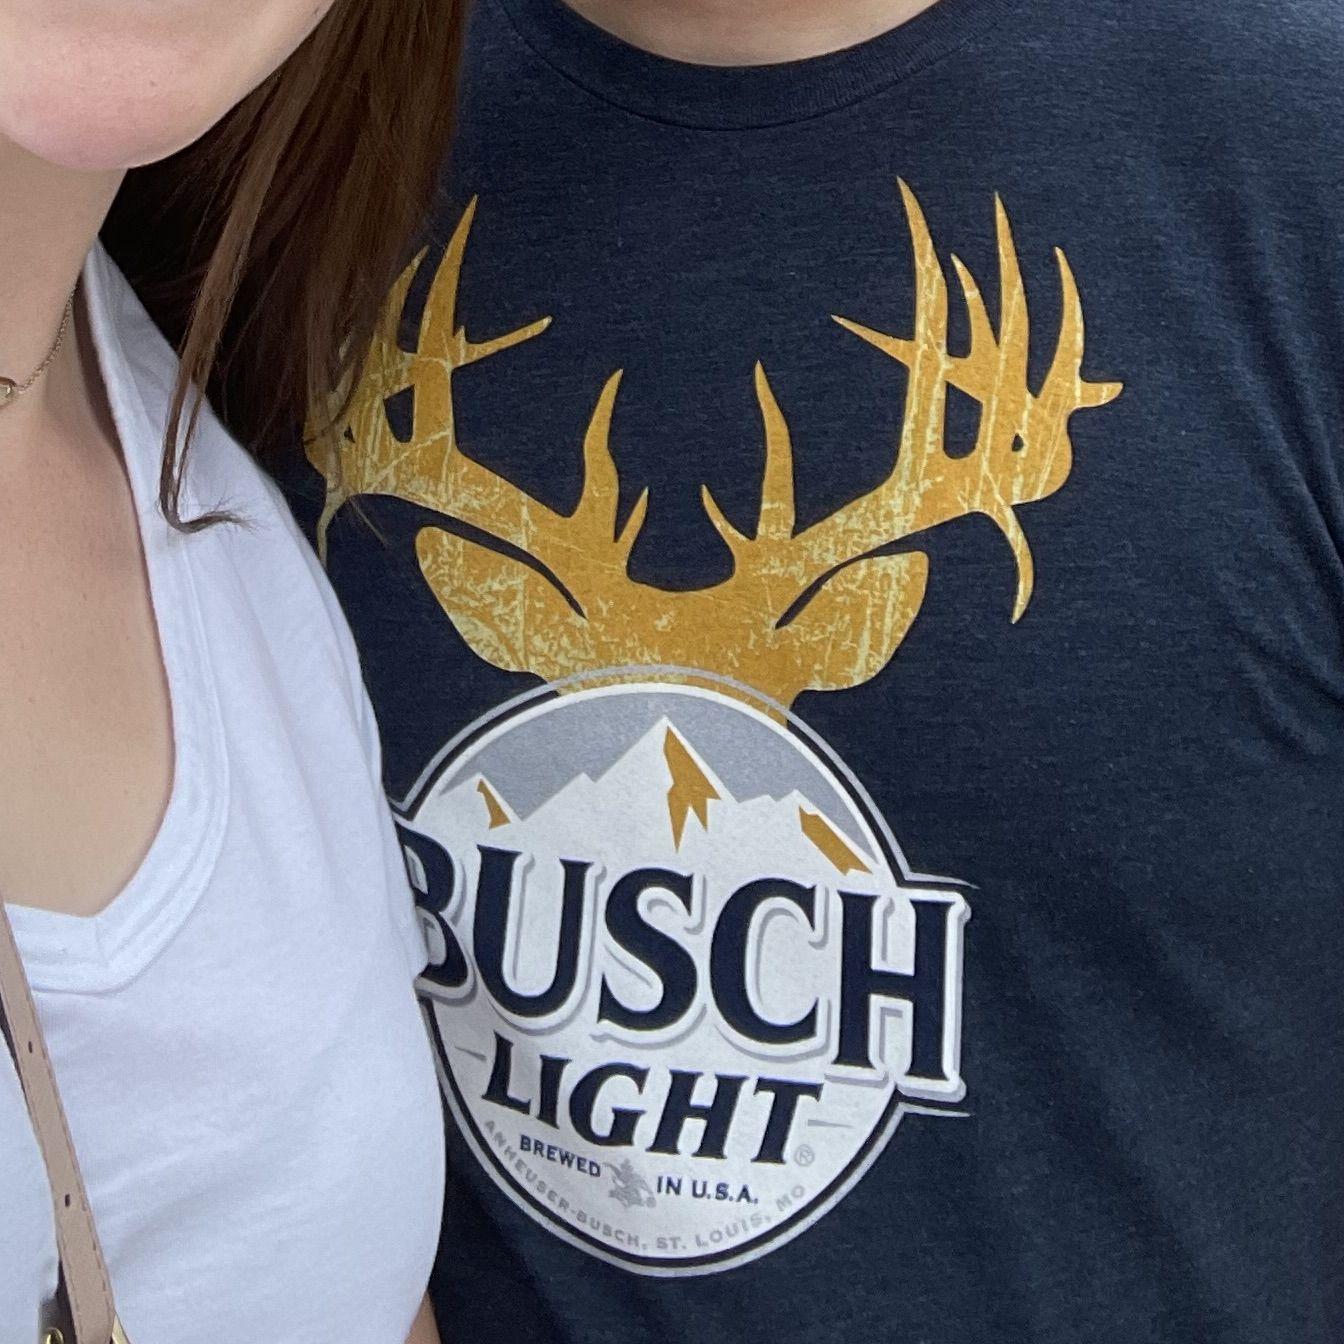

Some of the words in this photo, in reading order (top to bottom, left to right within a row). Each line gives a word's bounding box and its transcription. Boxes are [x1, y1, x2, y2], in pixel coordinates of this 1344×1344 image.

[404, 823, 957, 1083] BUSCH
[481, 1031, 826, 1166] LIGHT
[518, 1133, 602, 1179] BREWED
[656, 1174, 682, 1196] IN
[690, 1177, 760, 1205] U.S.A.
[655, 1235, 688, 1251] ST.
[775, 1184, 806, 1214] MO
